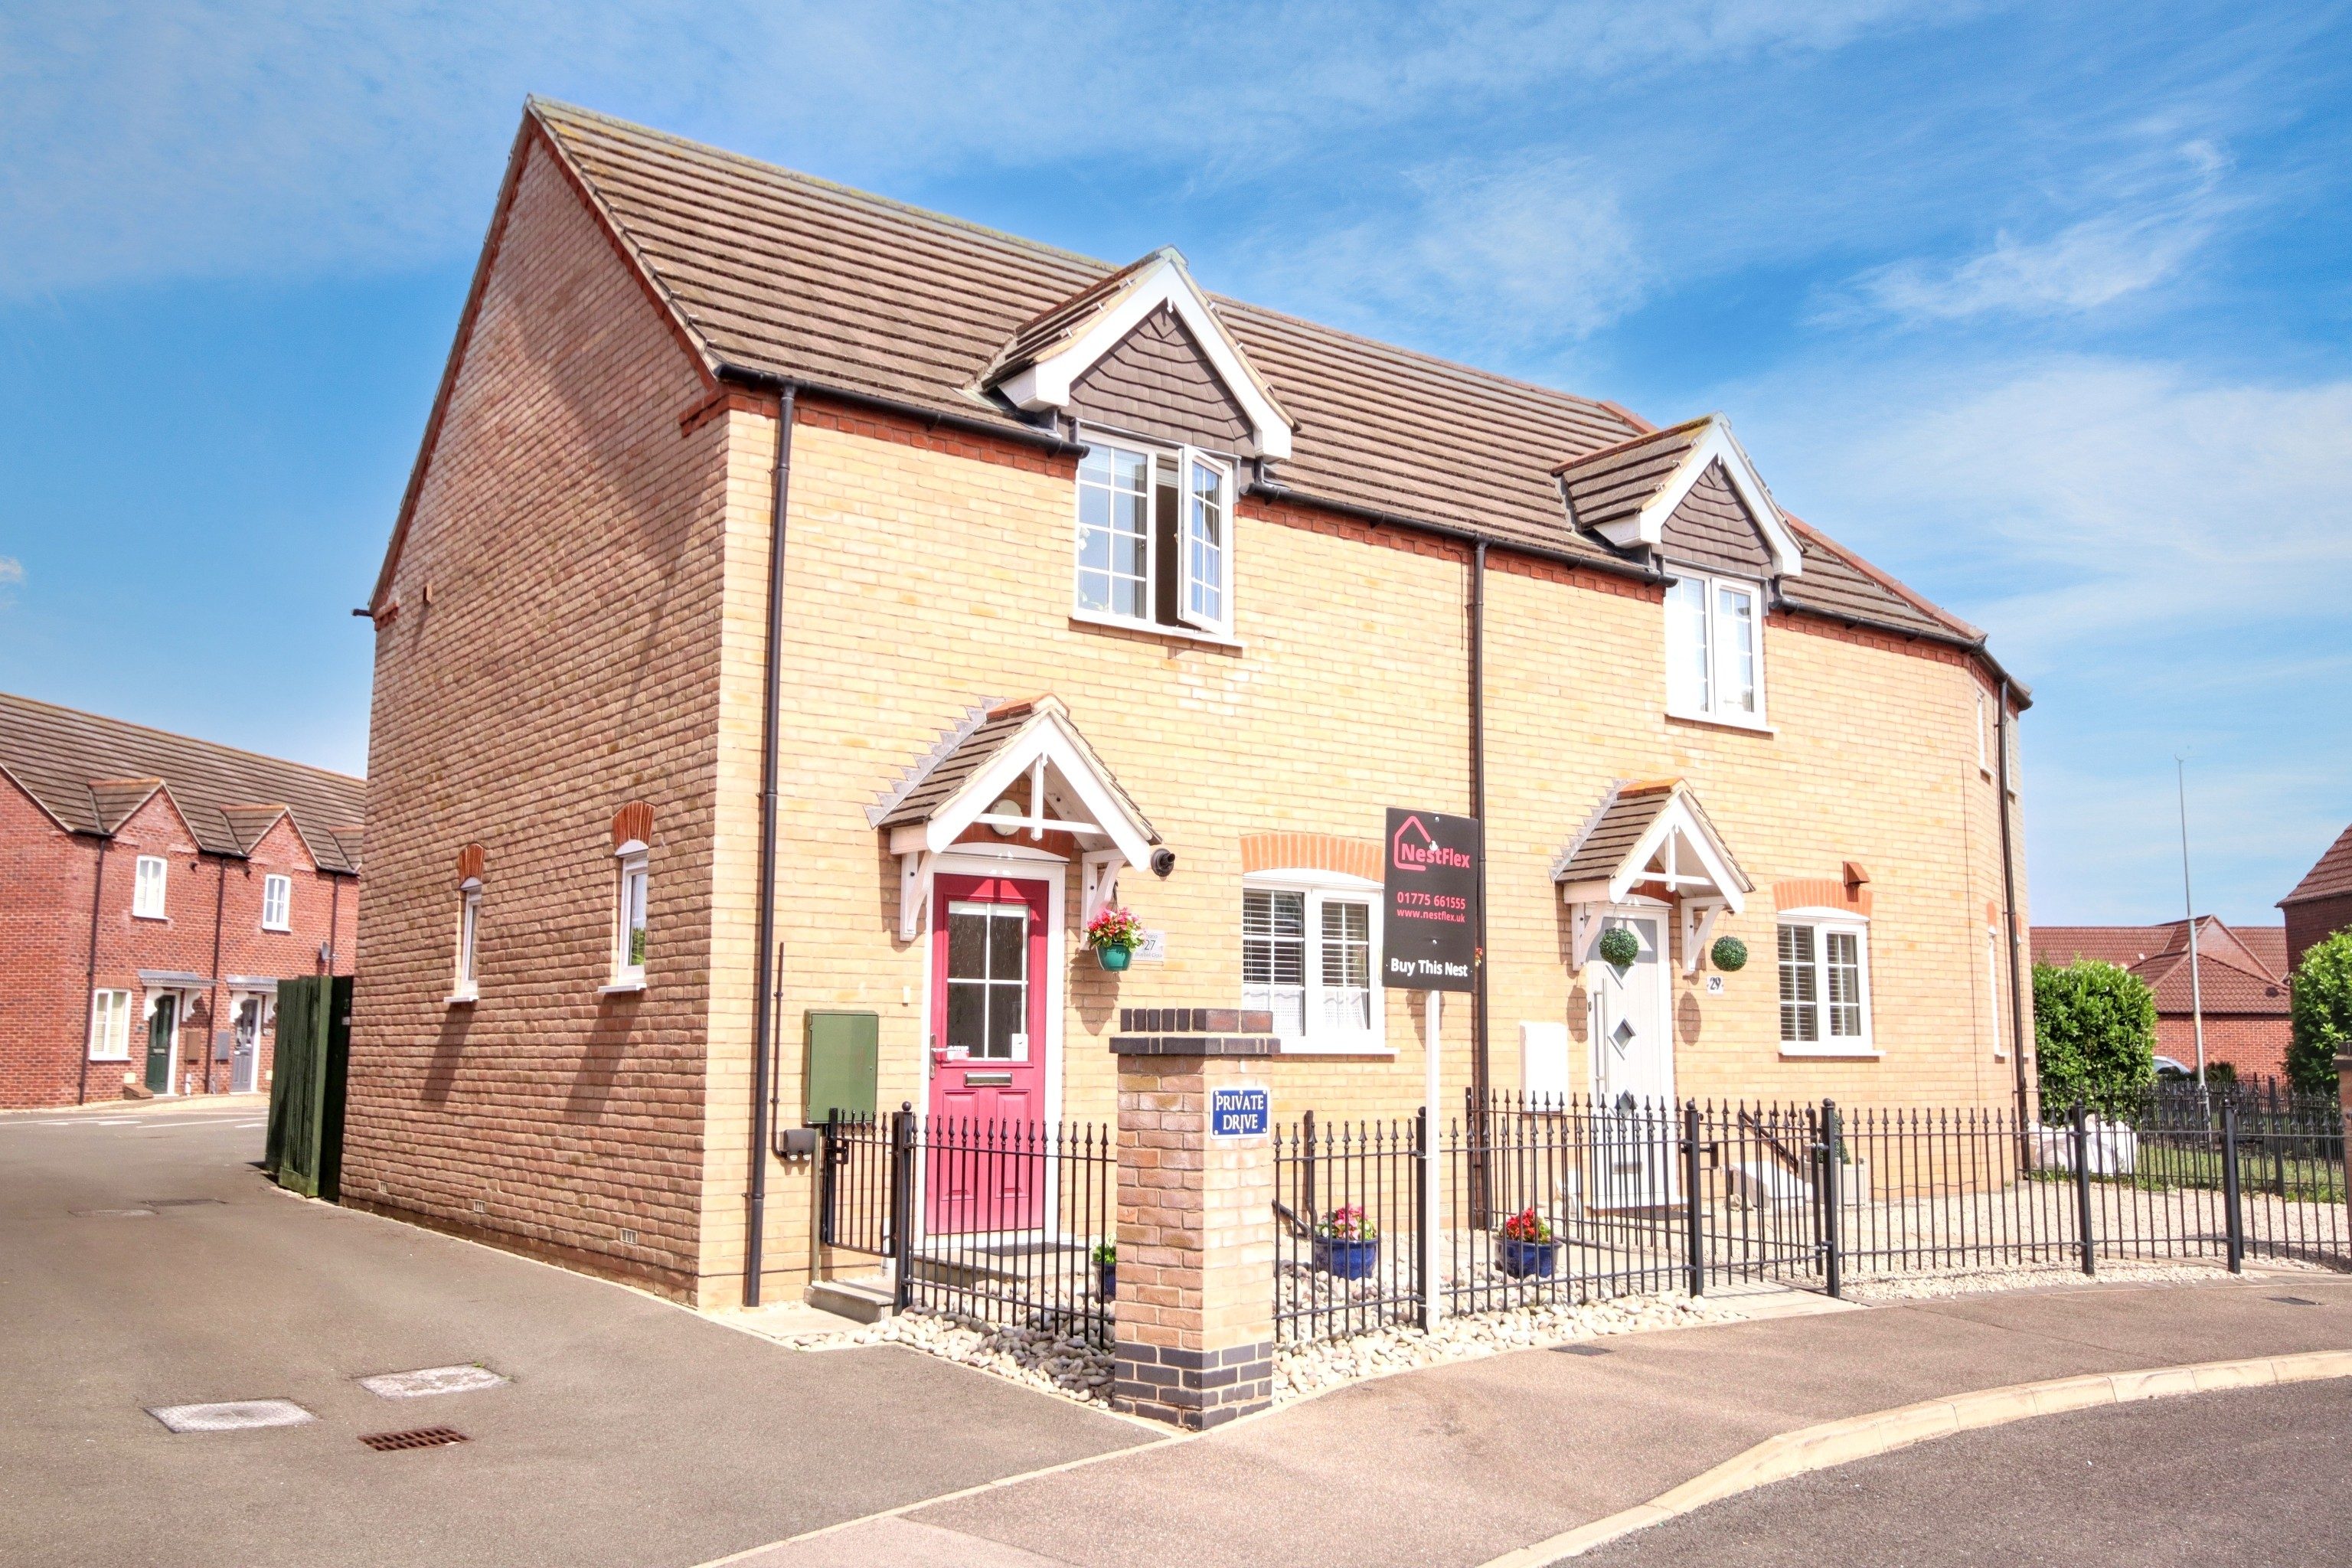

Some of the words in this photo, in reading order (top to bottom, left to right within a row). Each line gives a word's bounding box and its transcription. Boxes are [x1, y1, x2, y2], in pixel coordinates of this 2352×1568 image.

[1401, 843, 1470, 868] NestFlex
[1397, 891, 1431, 905] 01775
[1433, 895, 1466, 910] 661555
[1396, 909, 1465, 923] www.nestflex.uk
[1144, 939, 1157, 951] 27
[1390, 958, 1416, 977] Buy
[1418, 959, 1442, 975] This
[1445, 962, 1468, 977] Nest
[1710, 977, 1721, 990] 29
[1216, 1095, 1264, 1111] PRIVATE
[1223, 1114, 1258, 1130] DRIVE
